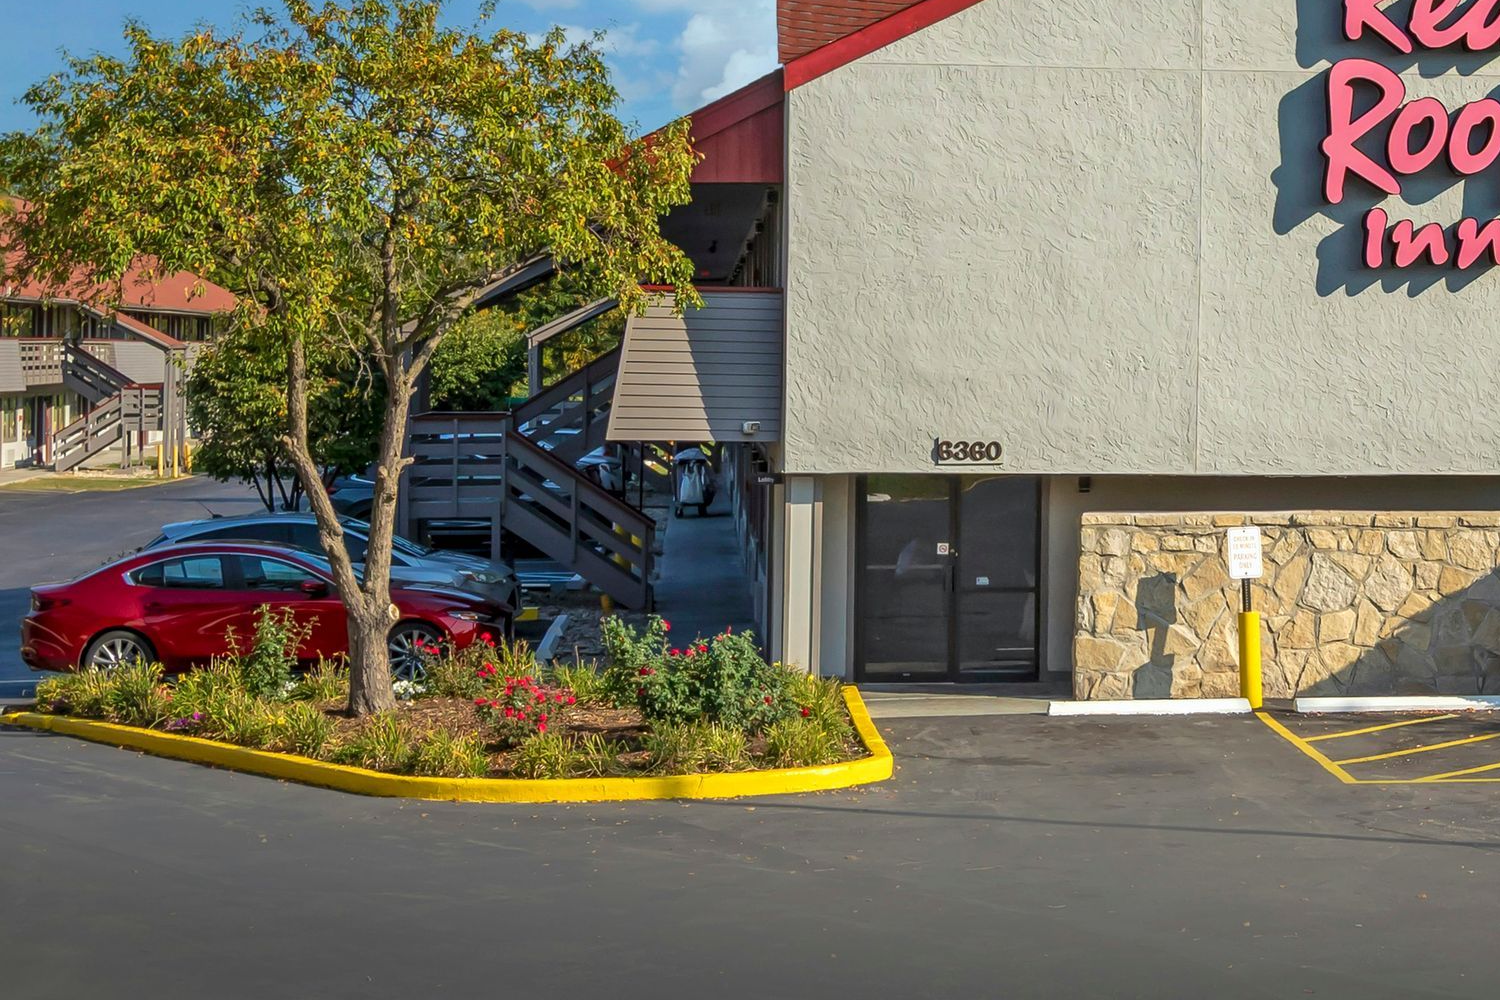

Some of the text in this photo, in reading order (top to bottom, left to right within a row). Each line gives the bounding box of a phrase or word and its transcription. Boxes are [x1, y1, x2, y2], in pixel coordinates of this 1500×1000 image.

[938, 440, 1002, 461] 6360
[1233, 552, 1257, 560] PARKING
[1238, 561, 1253, 569] ONLY
